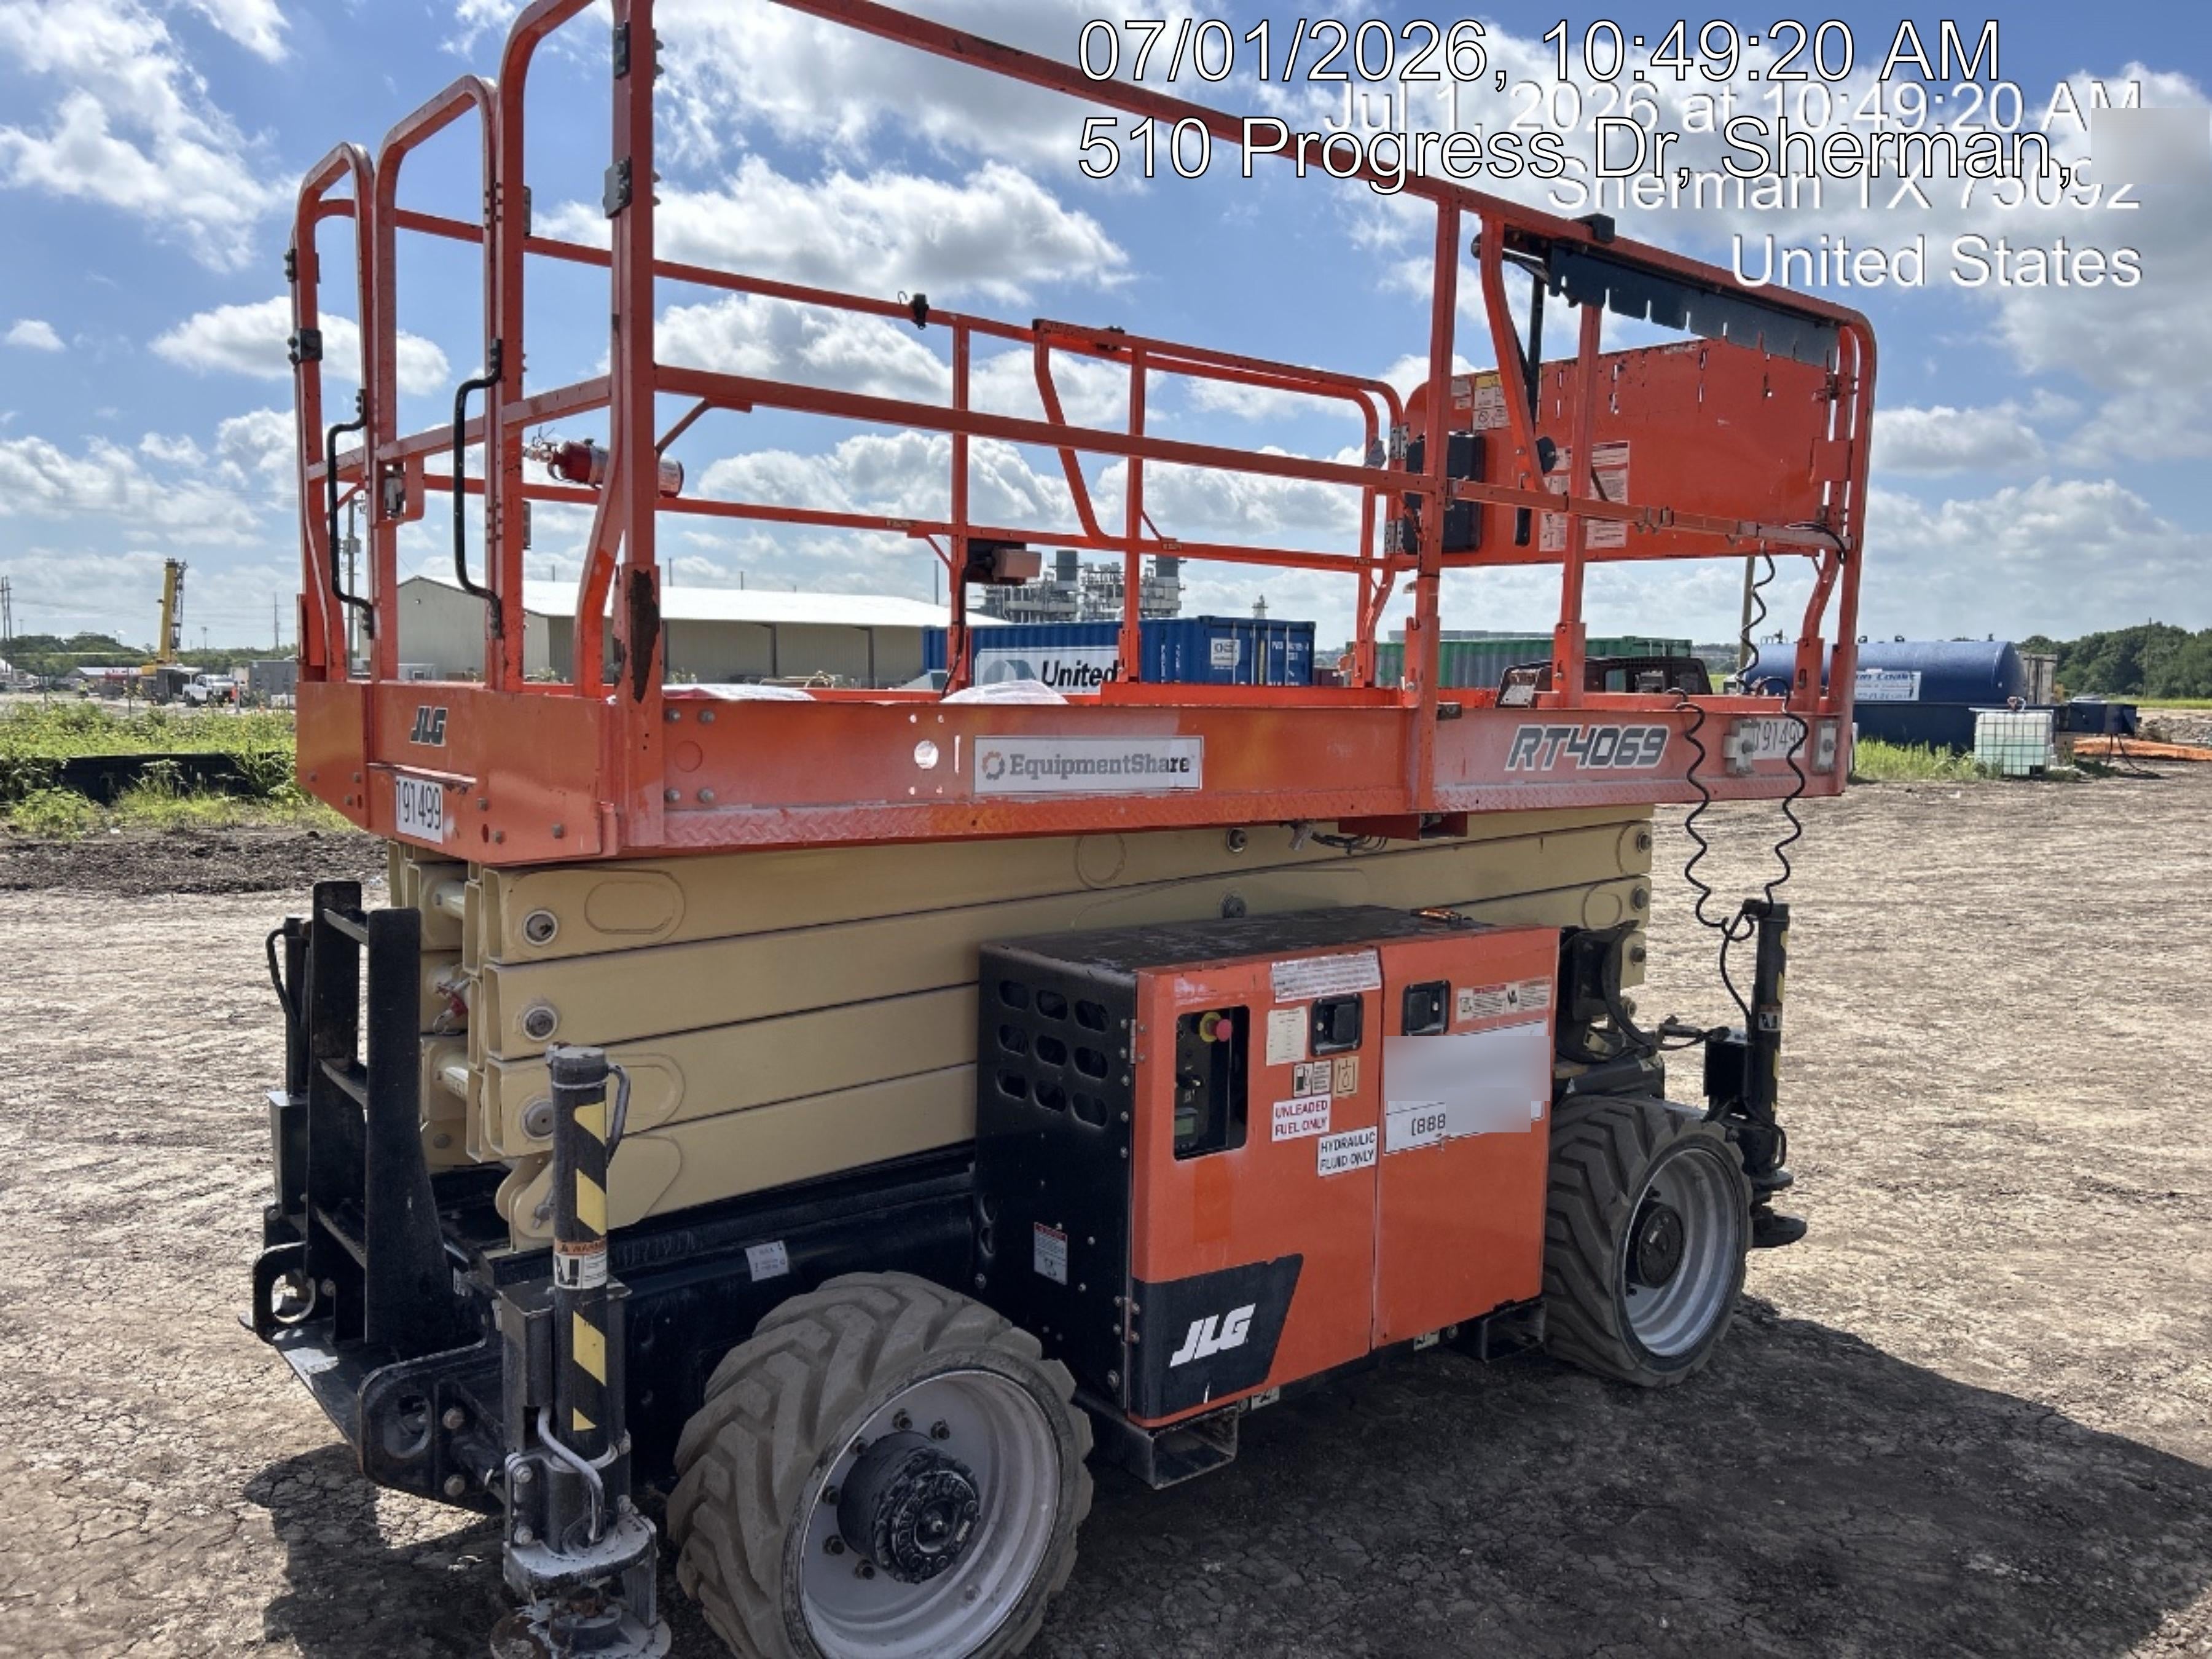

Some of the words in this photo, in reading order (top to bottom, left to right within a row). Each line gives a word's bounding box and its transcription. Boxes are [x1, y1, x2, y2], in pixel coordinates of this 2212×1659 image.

[1042, 659, 1118, 686] United
[409, 706, 449, 747] JLG
[1504, 724, 1669, 771] RT4069
[1010, 754, 1190, 780] EquipmentShare
[1275, 1100, 1328, 1119] UNLEADED
[1275, 1121, 1300, 1136] FUEL
[1302, 1116, 1327, 1131] ONLY
[1321, 1131, 1376, 1153] HYDRAULIC
[1320, 1156, 1348, 1171] FLUID
[1351, 1150, 1374, 1165] ONLY
[1169, 1303, 1257, 1368] JLG
